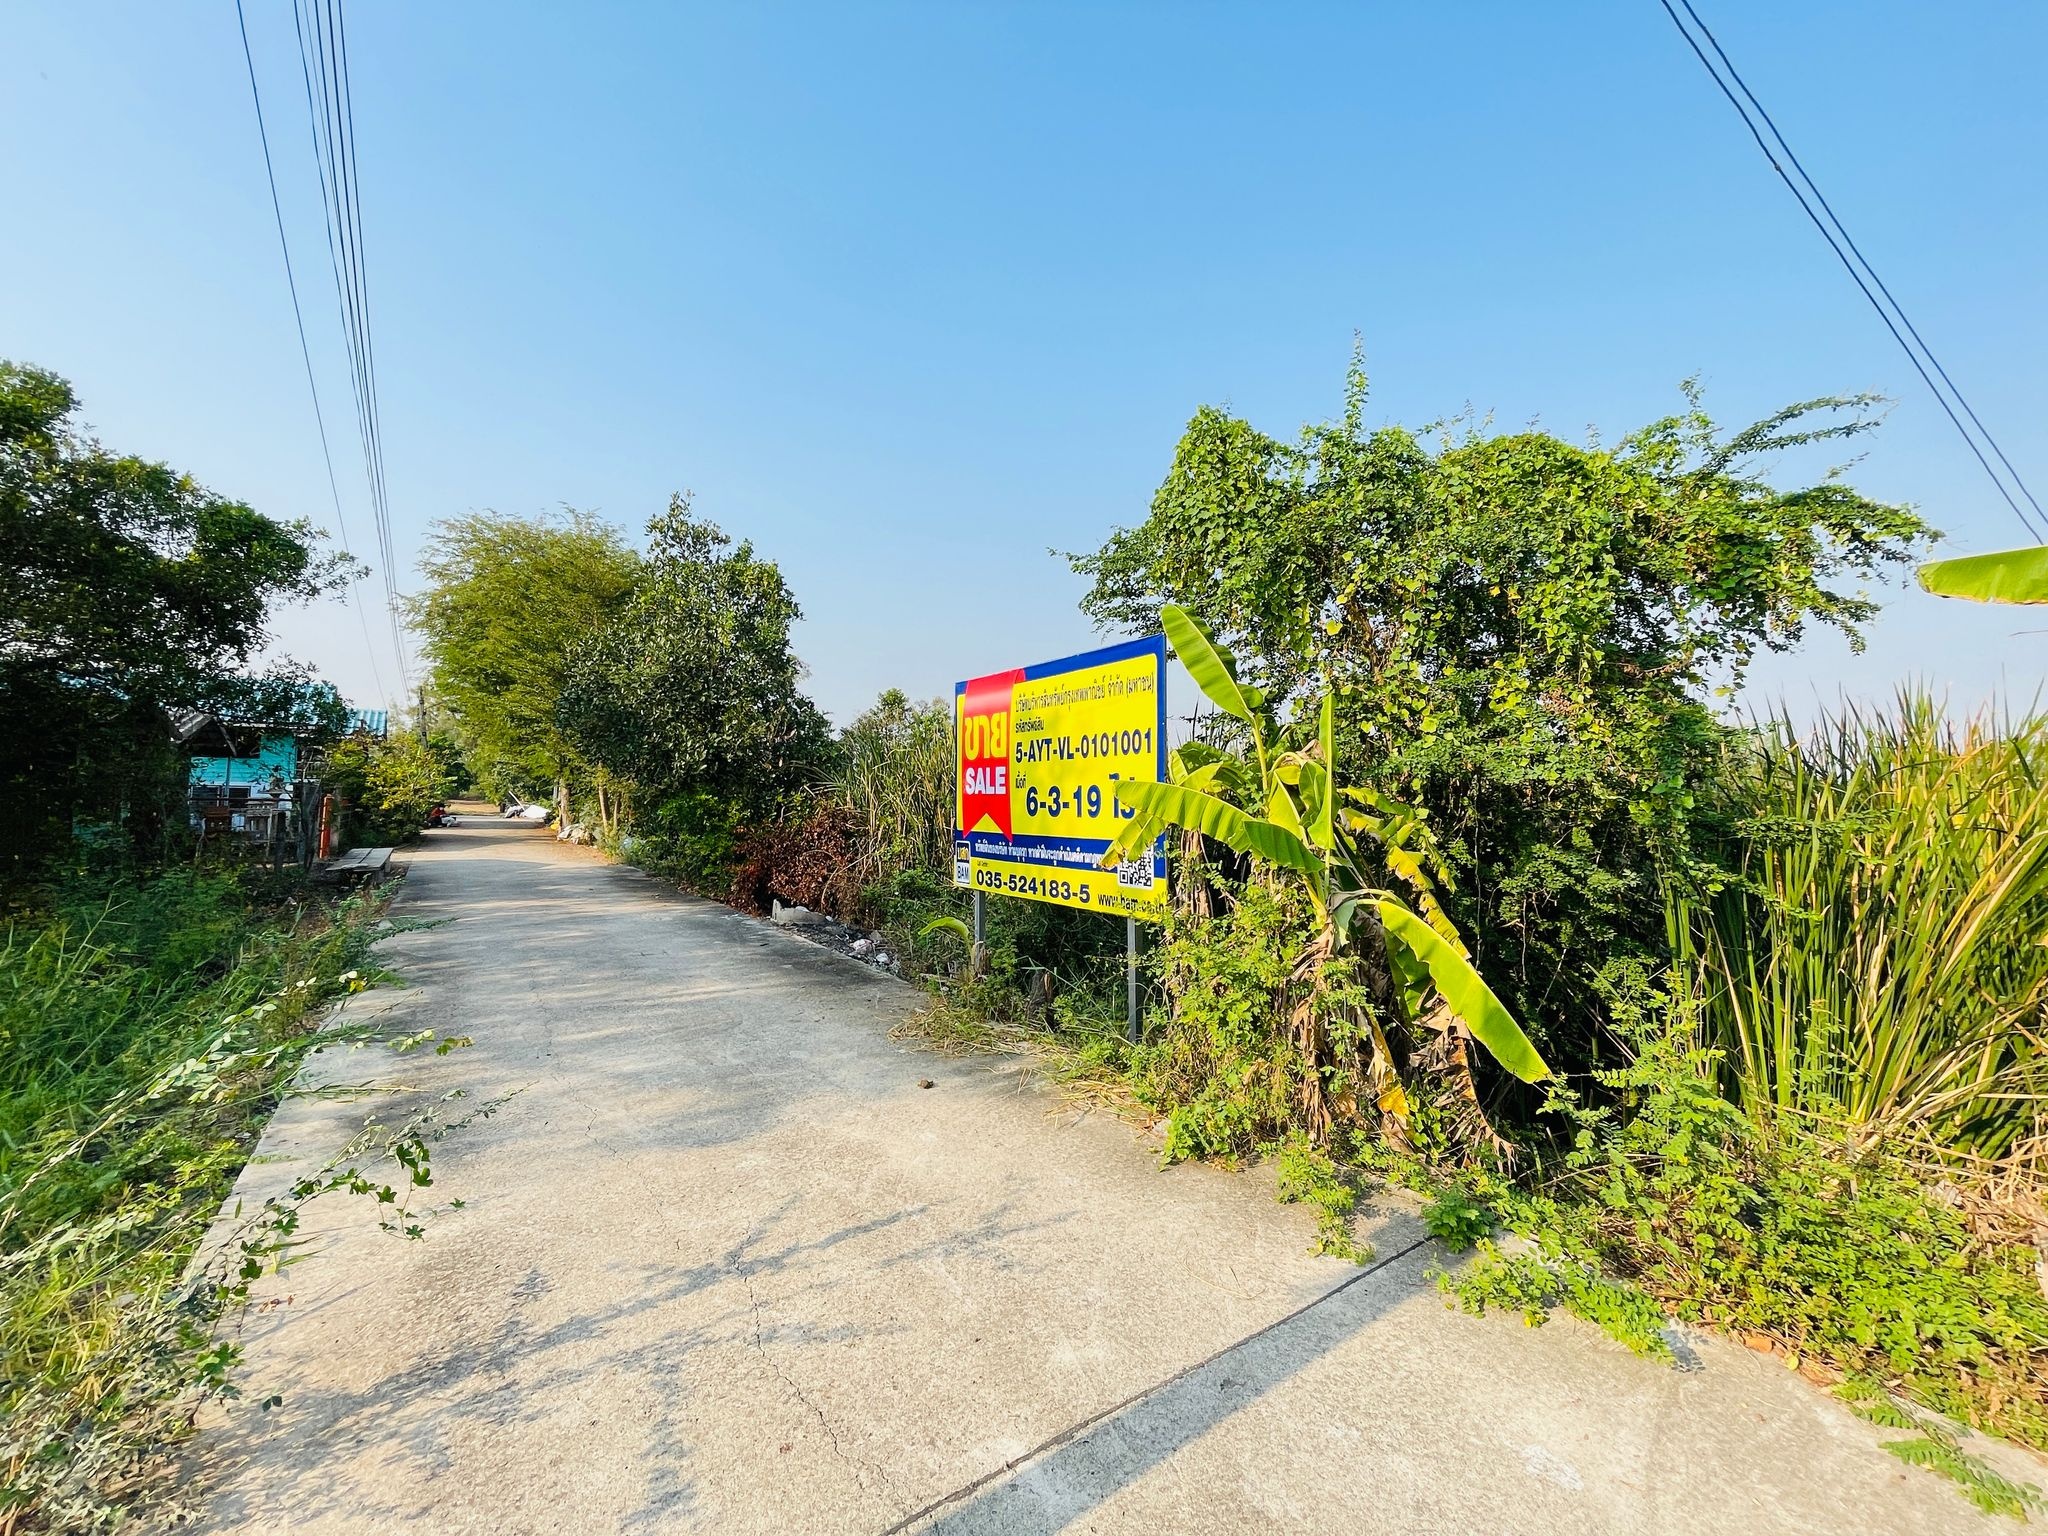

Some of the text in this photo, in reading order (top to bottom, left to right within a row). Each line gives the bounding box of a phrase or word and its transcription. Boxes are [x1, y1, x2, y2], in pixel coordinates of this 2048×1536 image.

[964, 711, 1007, 760] ขาย
[1015, 727, 1152, 763] 5-AYT-VL-0101001
[965, 766, 1006, 795] SALE
[1026, 784, 1102, 818] 6-3-19
[957, 865, 969, 879] BAM
[976, 869, 1091, 903] 035-524183-5
